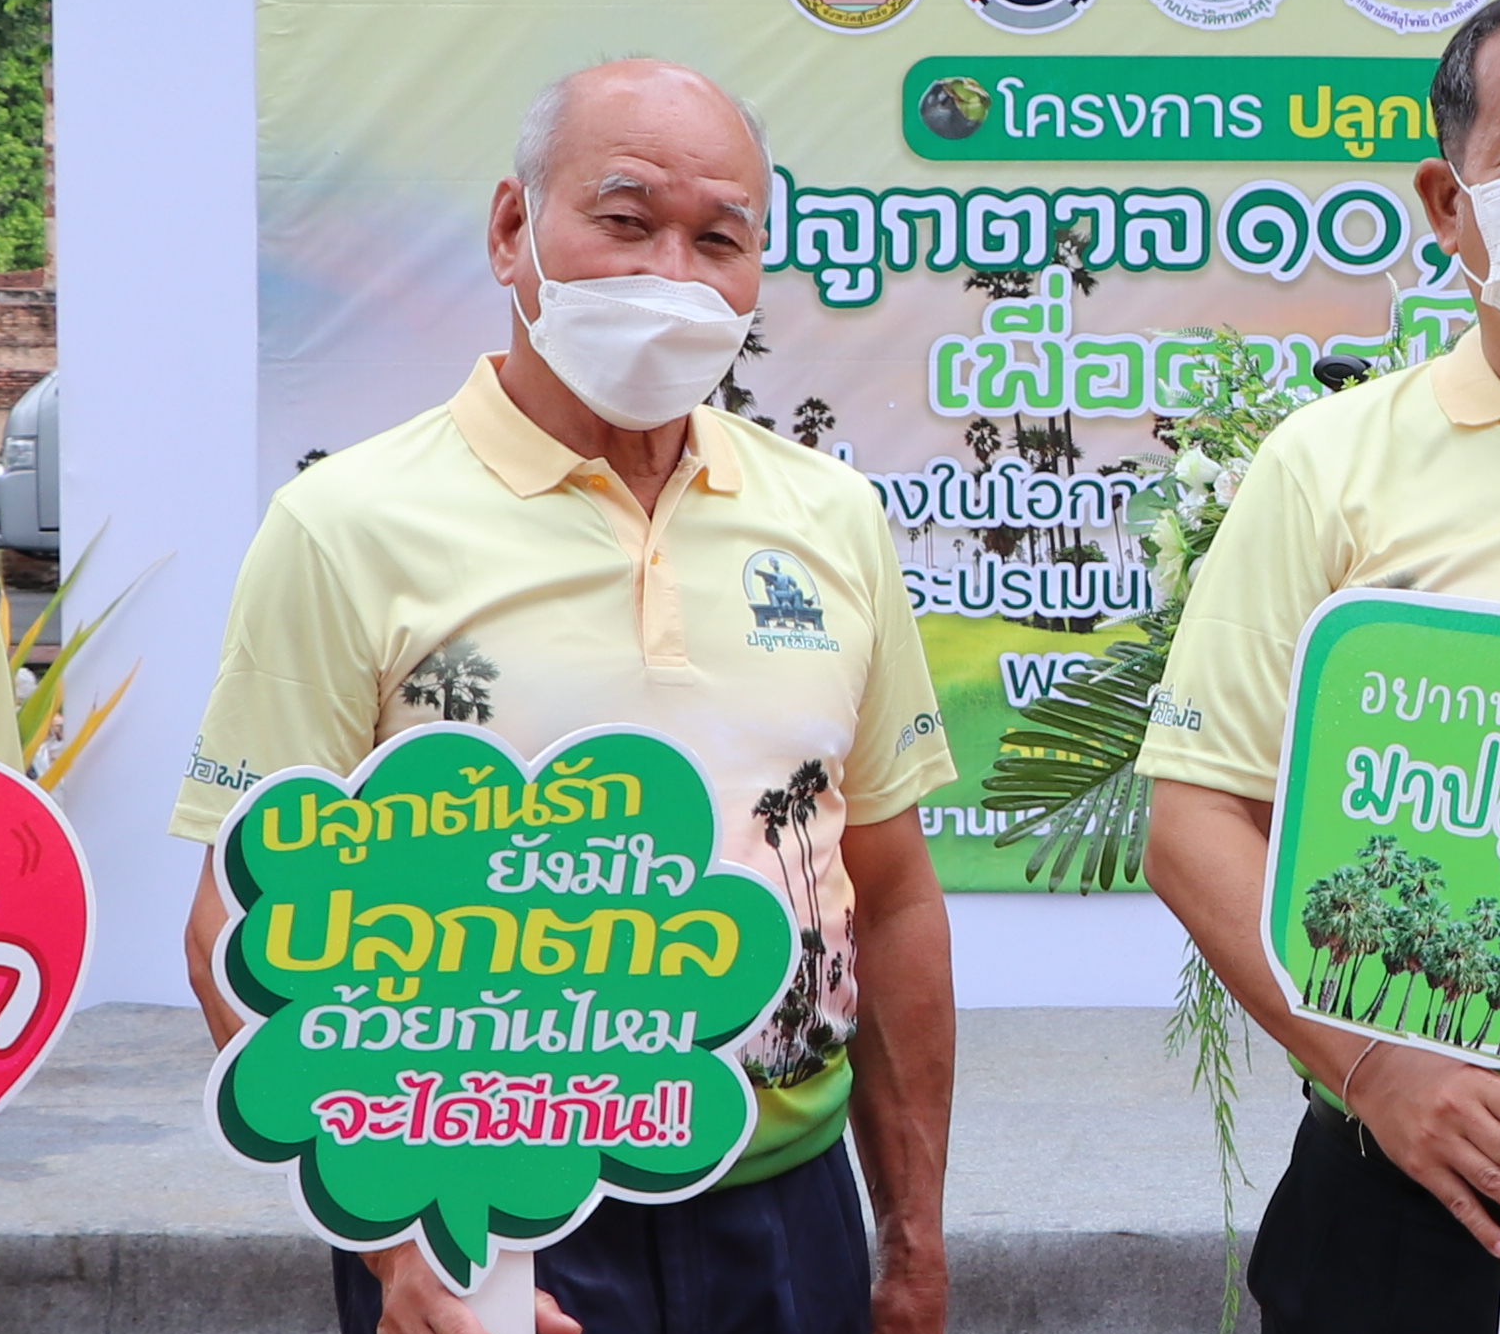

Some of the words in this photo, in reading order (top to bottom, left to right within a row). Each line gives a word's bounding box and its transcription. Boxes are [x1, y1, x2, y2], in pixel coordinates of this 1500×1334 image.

[997, 76, 1263, 140] โครงการ
[745, 625, 840, 653] ปลูกเพื่อพ่อ
[262, 757, 641, 864] ปลูกต้นรัก
[486, 833, 697, 897] ยังมีใจ
[265, 889, 740, 1002] ปลูกตาล
[299, 985, 697, 1053] ด้วยกันไหม
[314, 1071, 692, 1146] จะได้มีกัน!!
